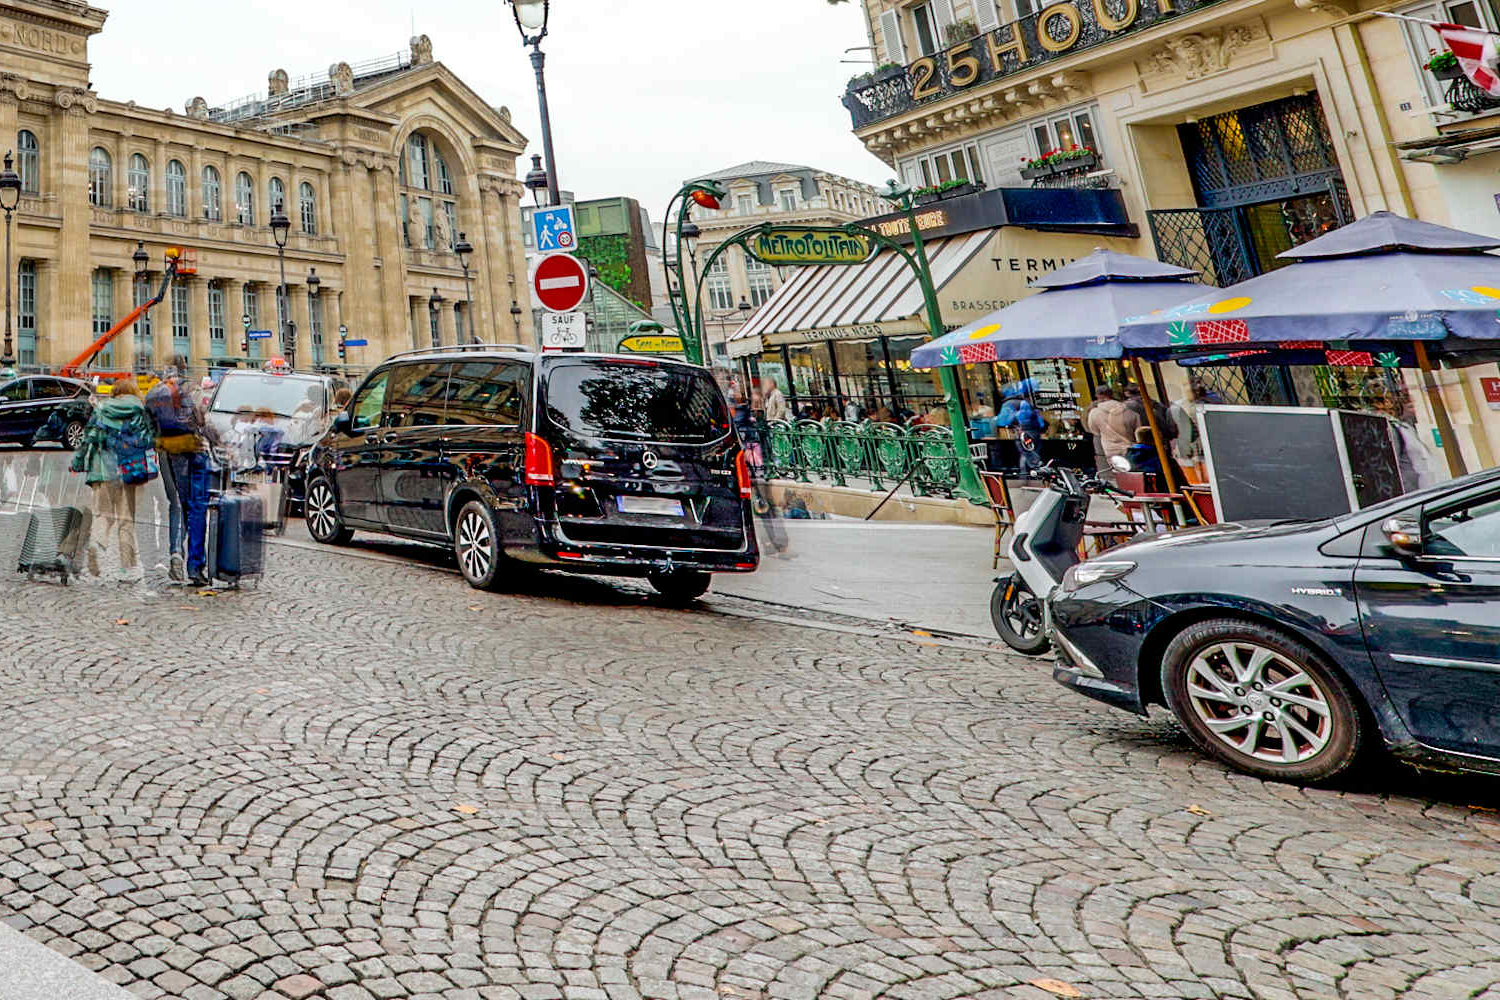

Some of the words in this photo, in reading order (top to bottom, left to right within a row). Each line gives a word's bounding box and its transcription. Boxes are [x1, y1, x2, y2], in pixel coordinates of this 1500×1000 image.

[12, 23, 69, 55] NORD
[759, 232, 865, 260] METROPOLITAIN
[552, 315, 575, 324] SAUF
[801, 328, 852, 341] TERMINUS
[853, 325, 883, 337] NORD
[1291, 587, 1334, 596] HYBRID
